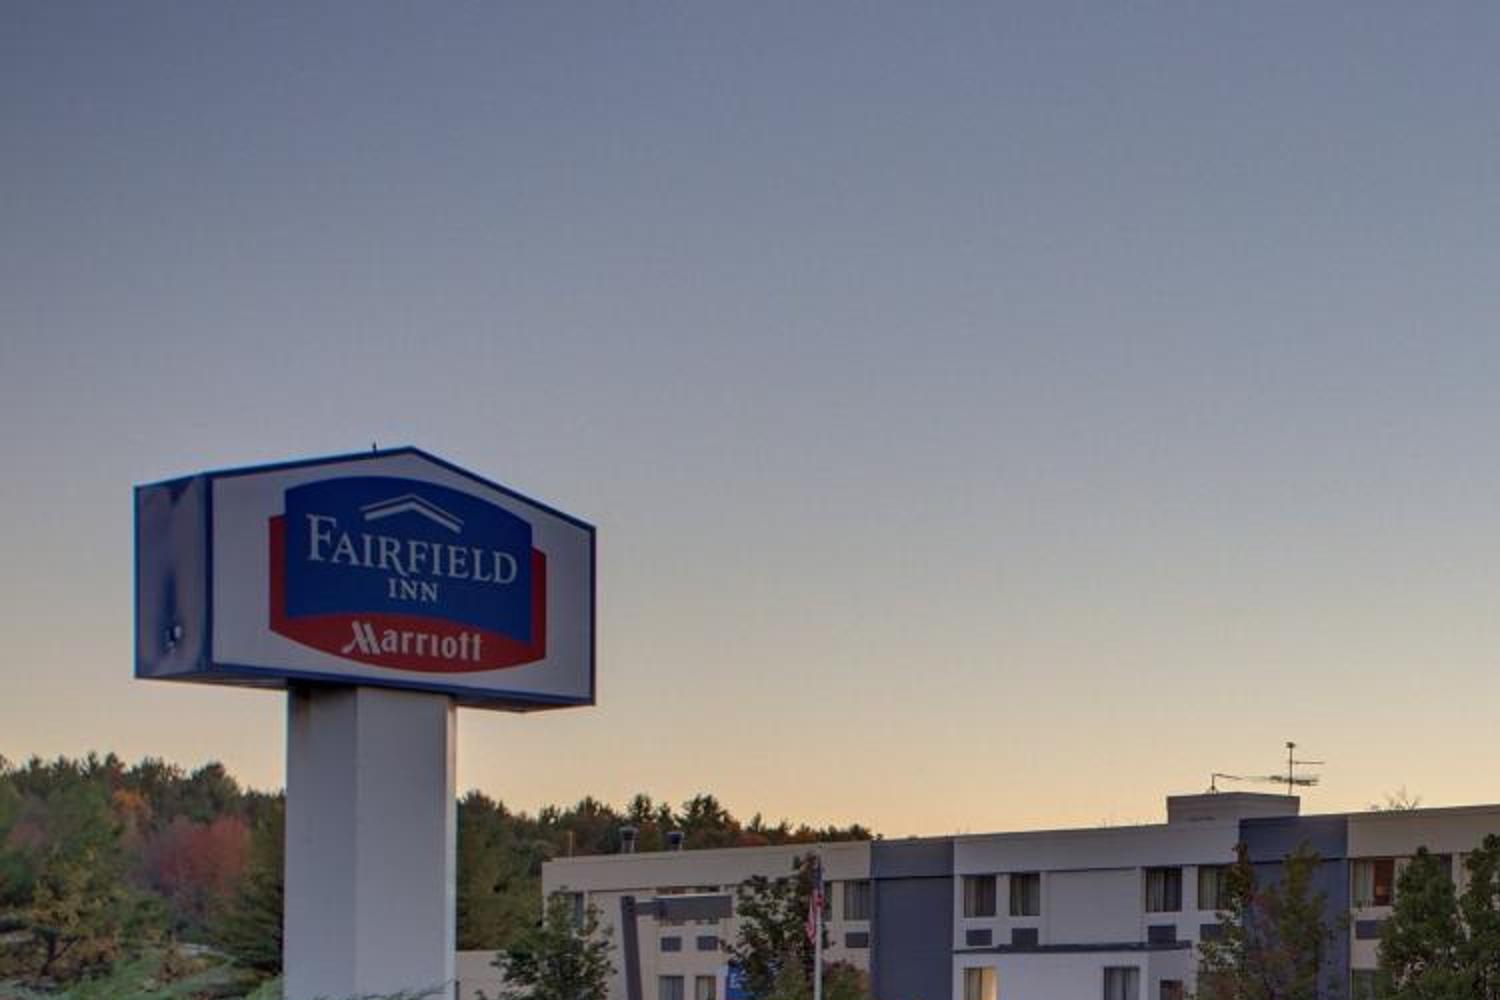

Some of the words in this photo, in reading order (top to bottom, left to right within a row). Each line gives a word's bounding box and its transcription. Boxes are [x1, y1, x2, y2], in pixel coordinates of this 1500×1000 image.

[305, 513, 518, 585] FAIRFIELD
[388, 577, 439, 602] INN
[341, 619, 482, 662] Marriott
